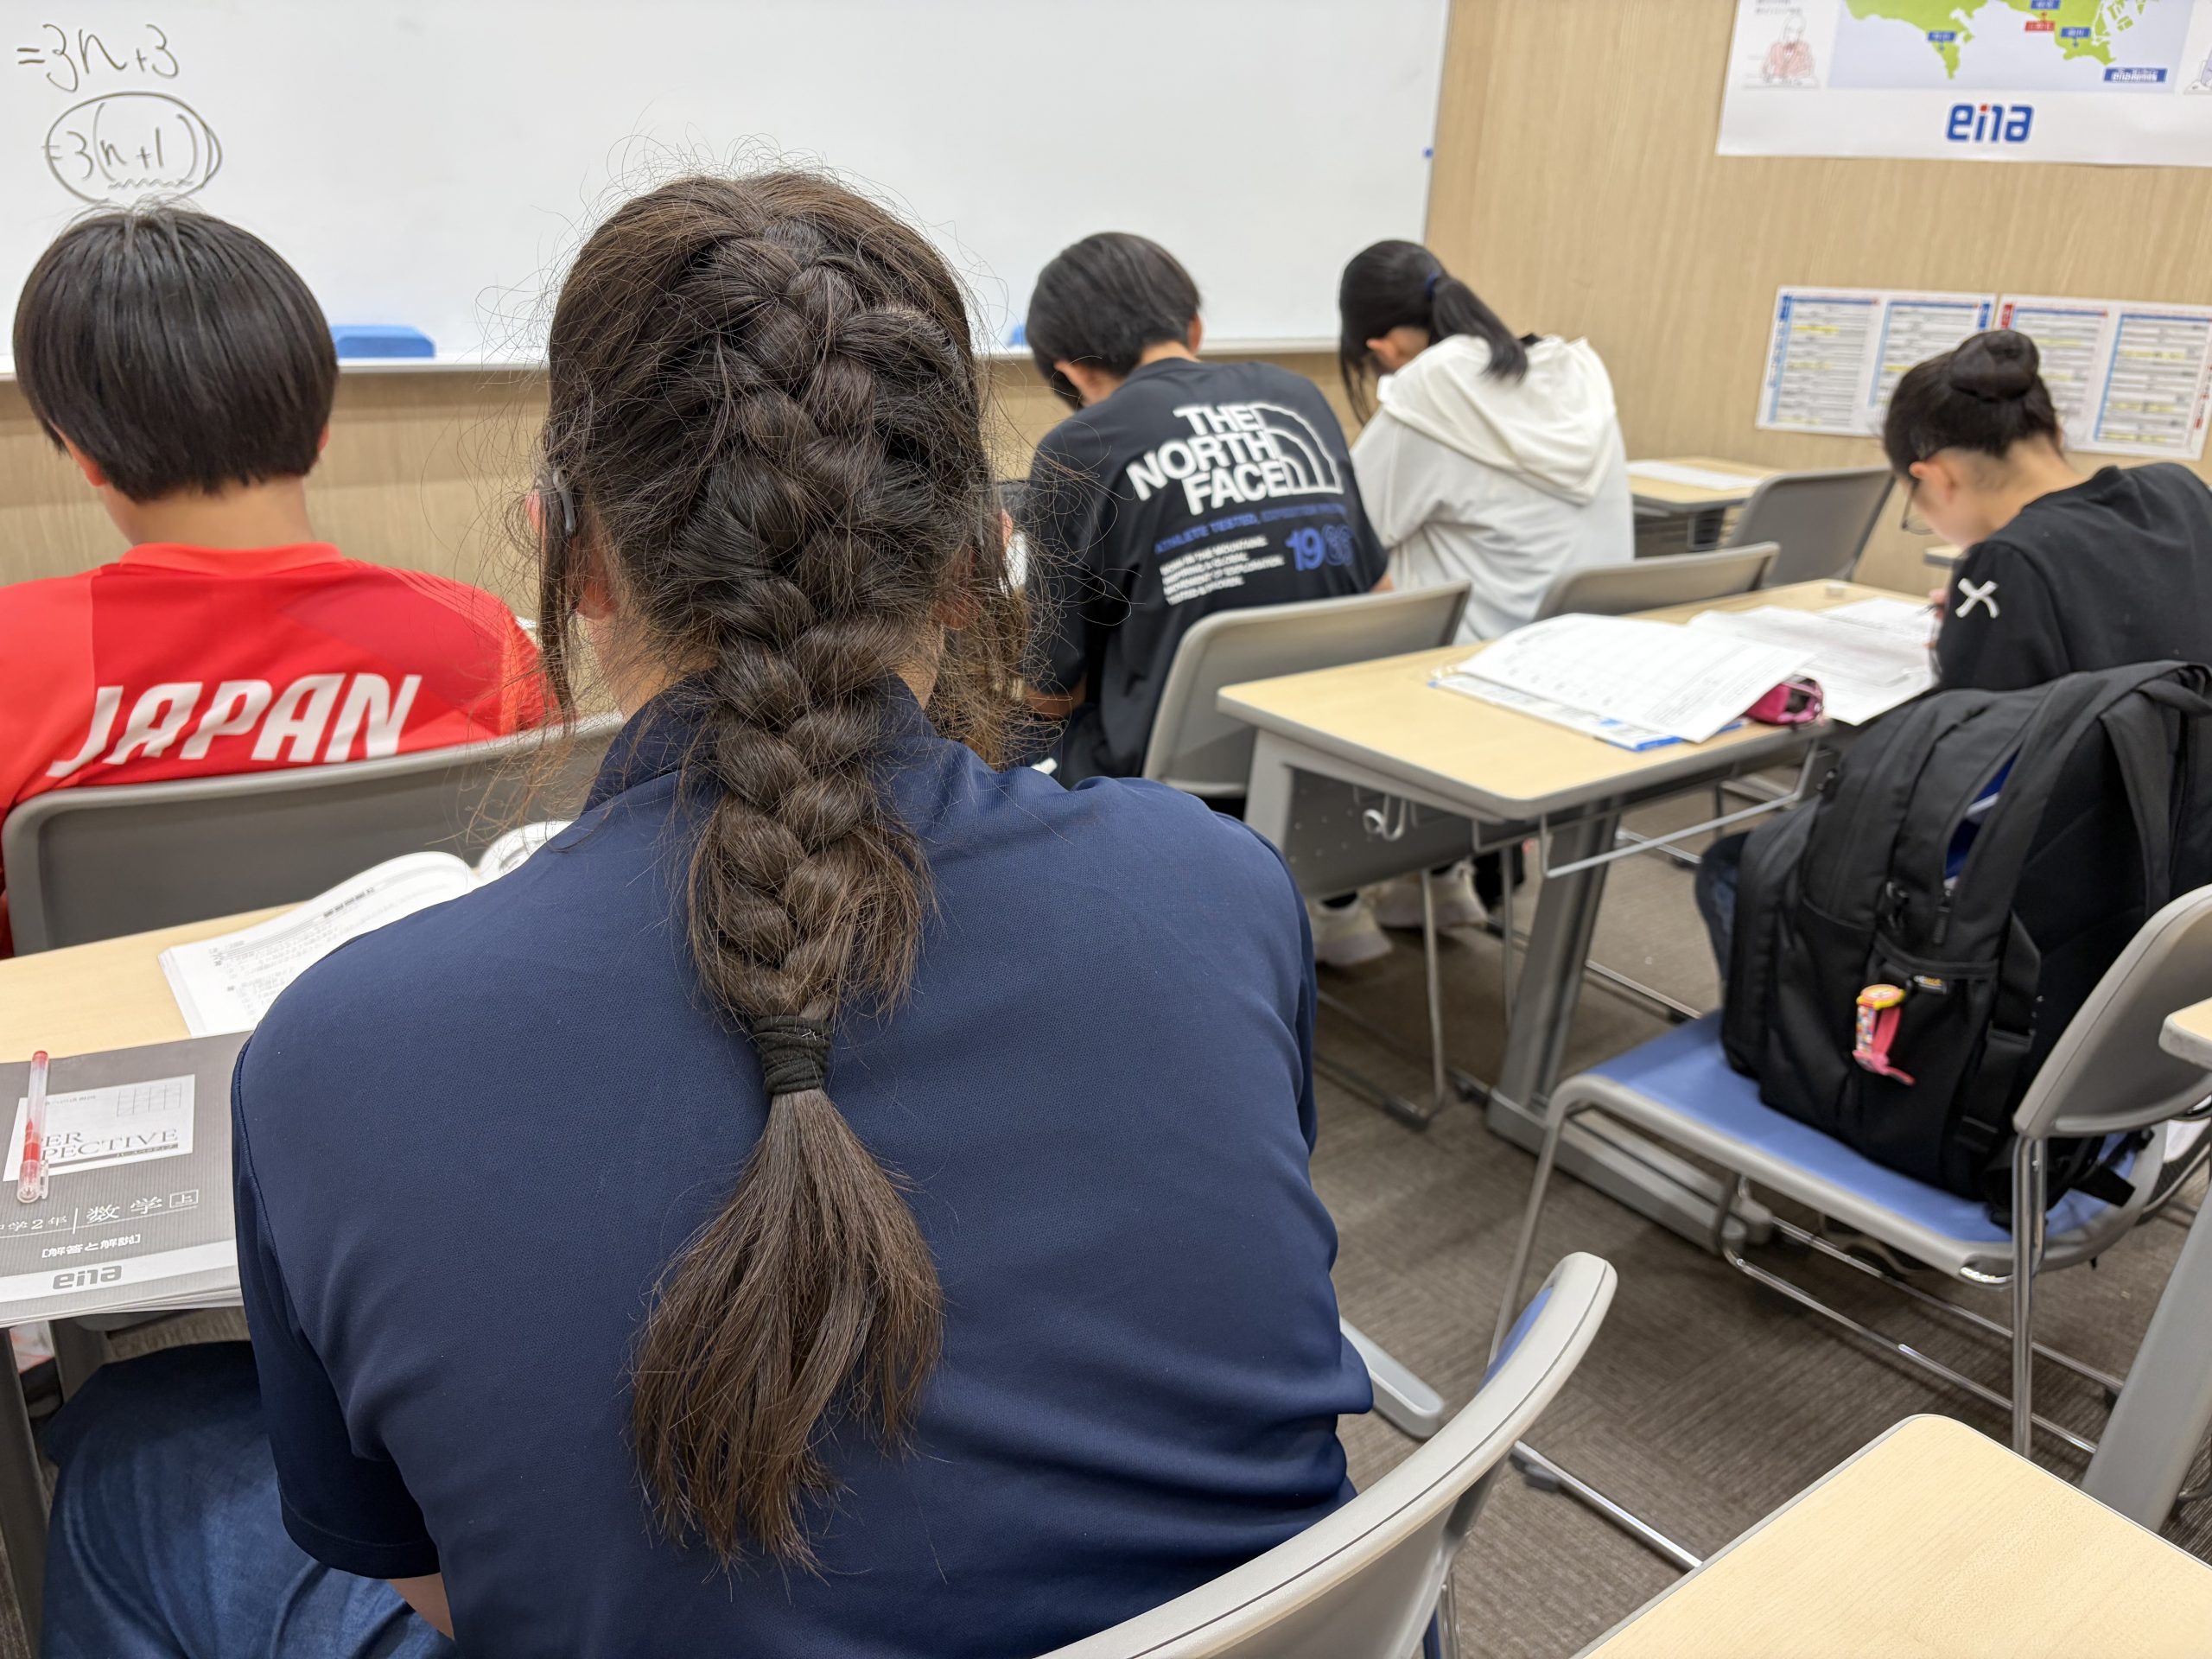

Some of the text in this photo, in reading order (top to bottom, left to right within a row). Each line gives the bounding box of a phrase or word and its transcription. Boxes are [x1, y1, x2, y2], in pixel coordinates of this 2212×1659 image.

[1173, 404, 1260, 435] THE
[1126, 430, 1276, 501] NORTH
[1181, 461, 1287, 516] FACE
[46, 672, 423, 777] JAPAN
[40, 1132, 83, 1147] ER
[41, 1128, 178, 1160] PECTIVE
[53, 1265, 122, 1290] ena
